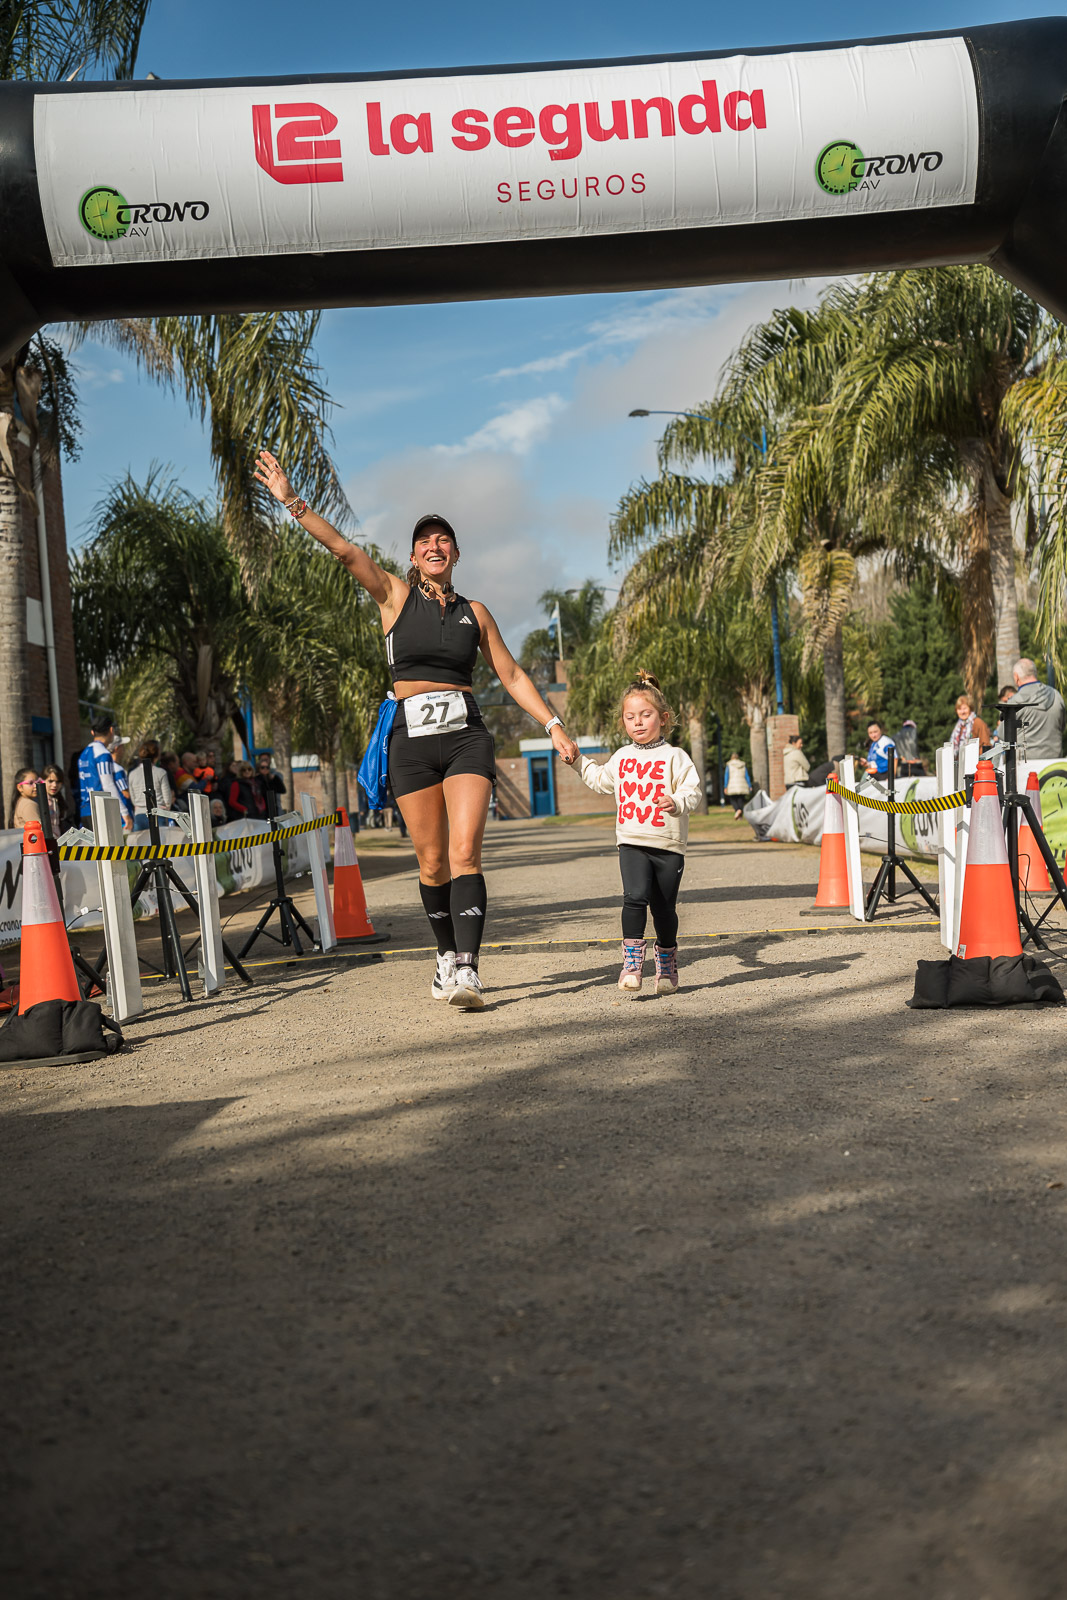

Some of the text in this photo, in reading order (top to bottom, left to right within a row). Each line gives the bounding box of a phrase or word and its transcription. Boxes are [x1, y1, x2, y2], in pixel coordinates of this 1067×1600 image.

[366, 102, 434, 156] la
[451, 79, 767, 161] segunda
[850, 151, 944, 178] CRONO
[497, 172, 647, 203] SEGUROS
[848, 179, 881, 192] RAV
[116, 201, 210, 224] CRONO
[116, 226, 149, 238] RAV
[420, 701, 450, 726] 27
[618, 758, 666, 780] LOVE
[618, 801, 666, 828] LOVE
